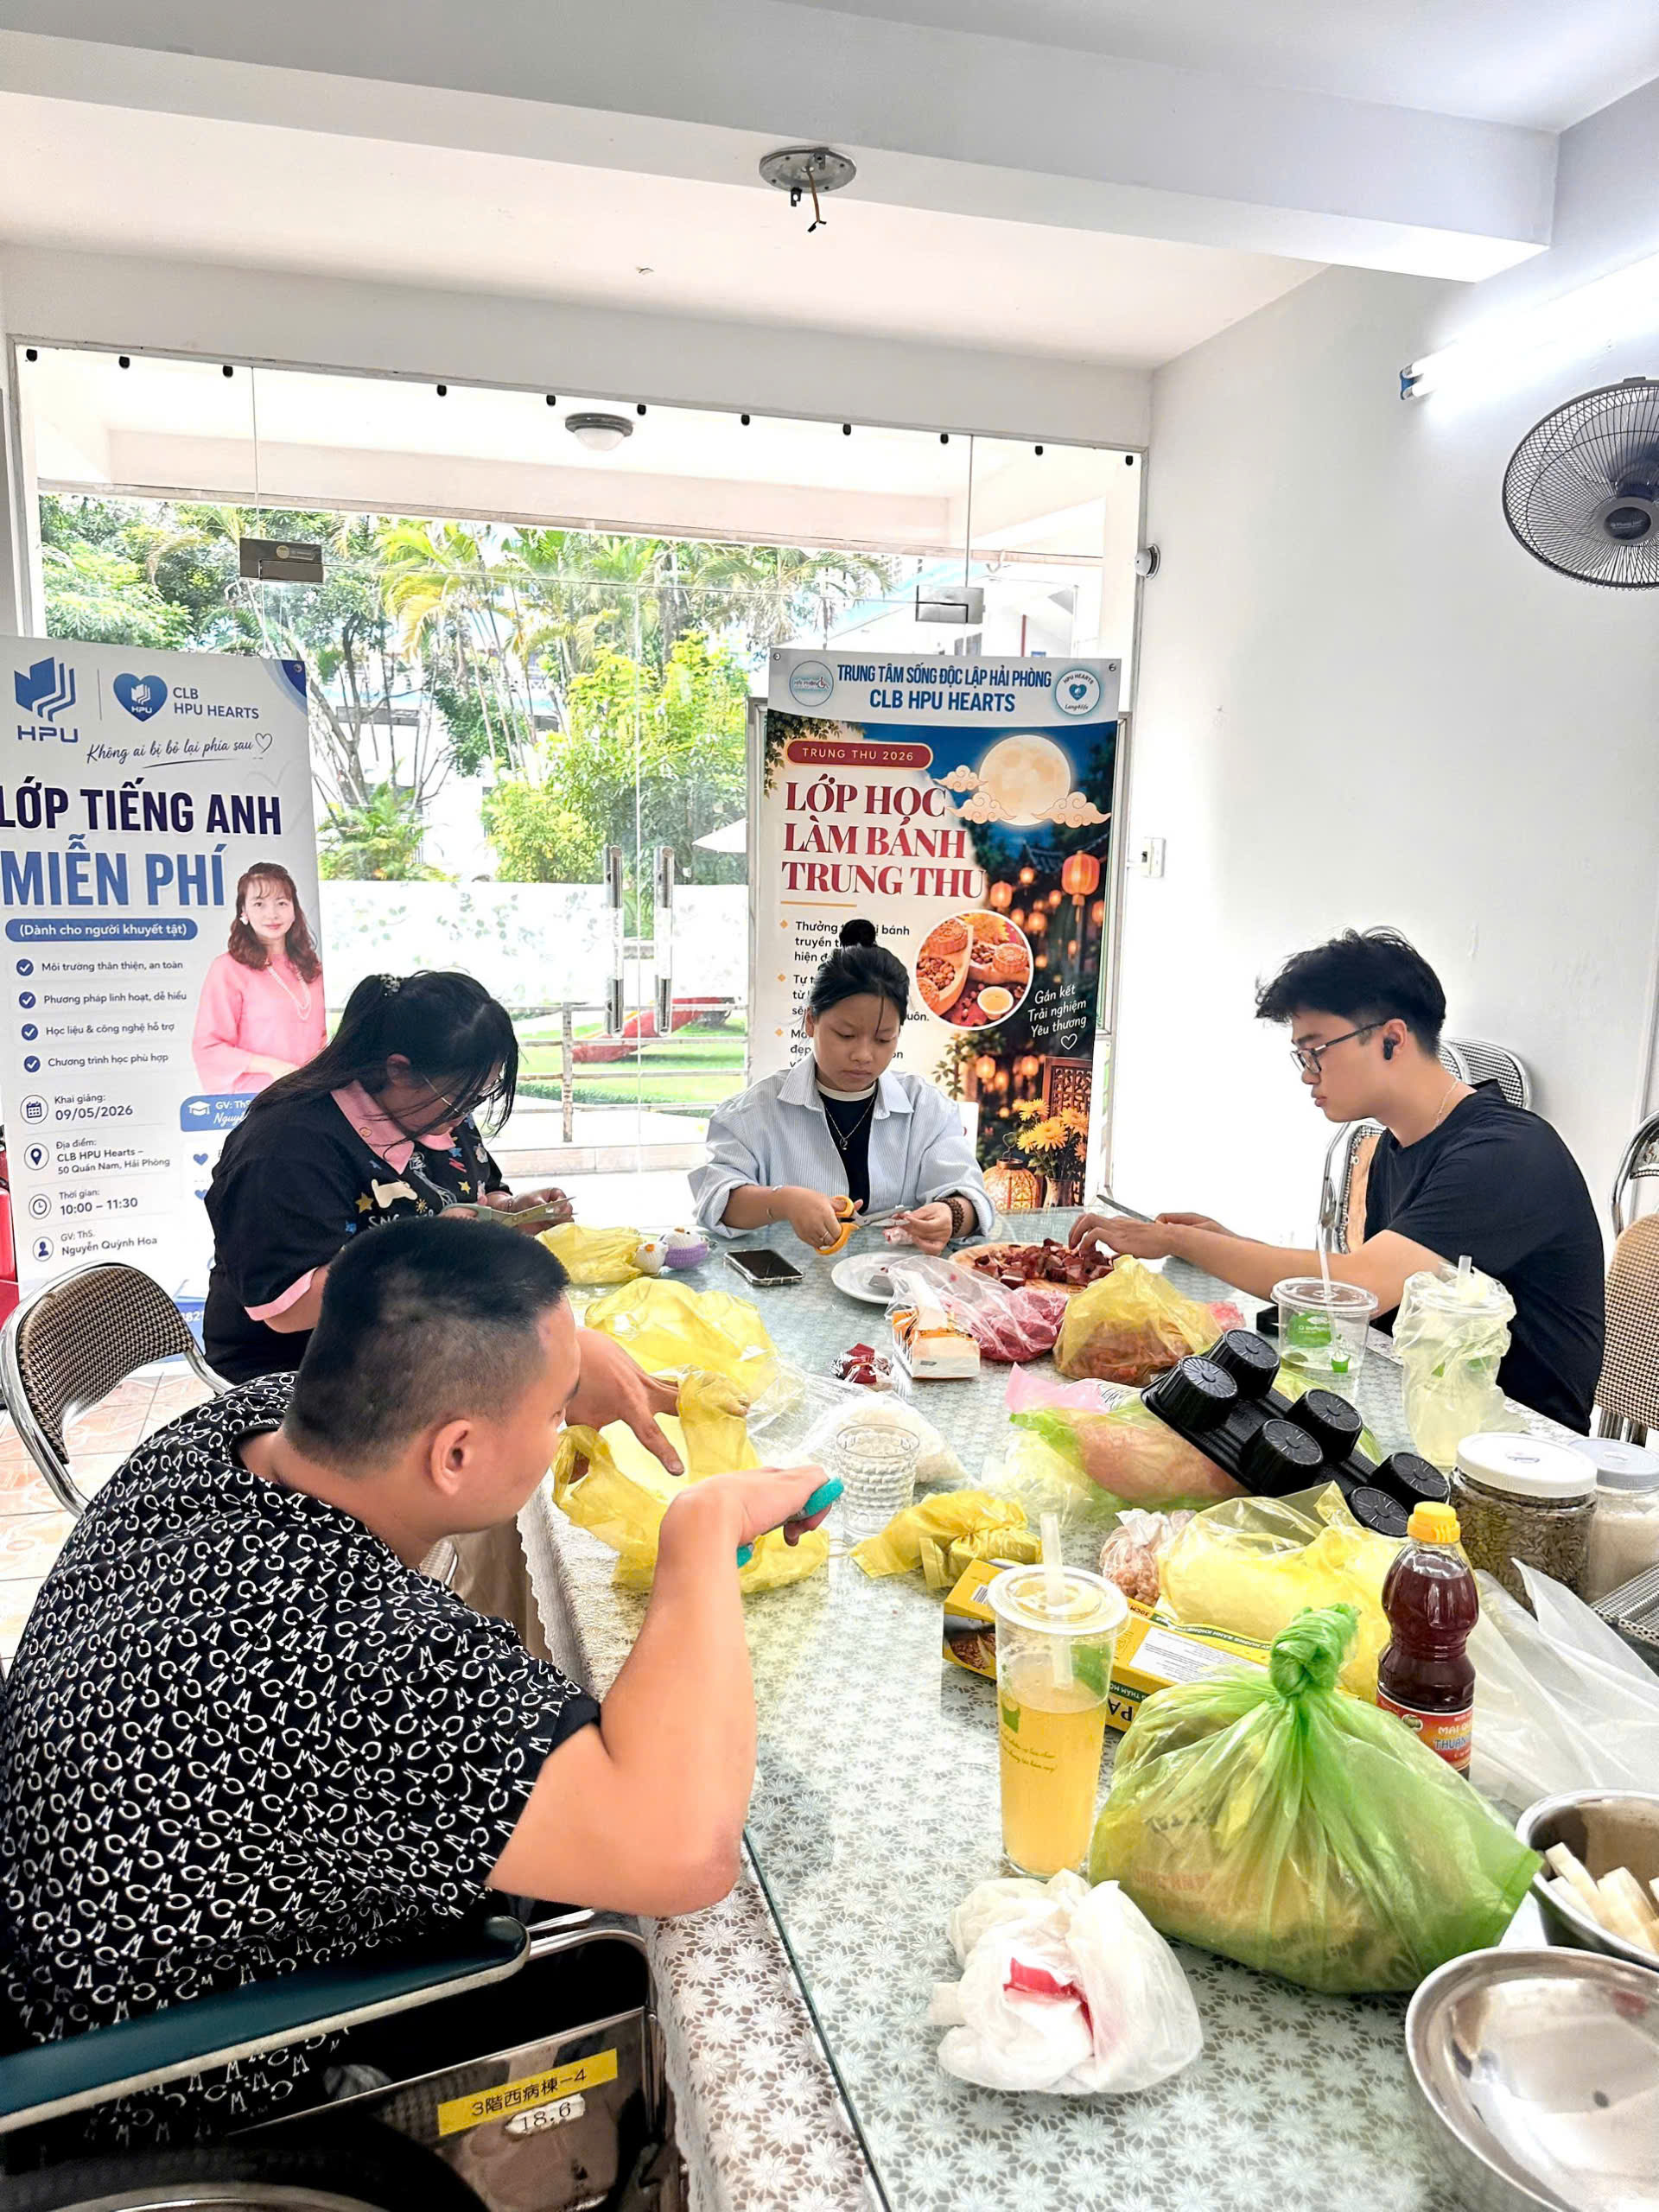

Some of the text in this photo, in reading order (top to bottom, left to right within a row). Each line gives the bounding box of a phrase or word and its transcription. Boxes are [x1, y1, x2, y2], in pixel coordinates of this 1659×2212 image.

[837, 662, 1052, 689] TRUNG TÂM SỐNG ĐỘC LẬP HẢI PHÒNG
[173, 687, 199, 699] CLB
[869, 689, 1016, 712] CLB HPU HEARTS
[174, 702, 259, 719] HPU HEARTS
[17, 725, 79, 743] HPU
[86, 737, 253, 765] Không ai bị bỏ lại phía sau
[802, 747, 913, 761] TRUNG THU 2026
[785, 773, 858, 813] LỚP
[0, 776, 283, 836] LỚP TIẾNG ANH
[784, 815, 968, 859] LÀM BÁNH
[0, 834, 227, 906] MIỄN PHÍ
[781, 861, 986, 899] TRUNG THU
[20, 923, 187, 938] (Dành cho người khuyết tật)
[796, 921, 838, 934] Thưởng
[881, 925, 910, 935] bánh
[795, 936, 831, 949] truyền
[794, 951, 817, 963] hiện
[42, 963, 60, 971] Môi
[62, 962, 95, 973] trường
[98, 961, 118, 970] thân
[121, 961, 147, 972] thiện,
[163, 961, 183, 969] toàn
[793, 975, 808, 988] Tự
[44, 995, 80, 1005] Phương
[83, 994, 106, 1005] pháp
[128, 993, 151, 1002] hoạt,
[154, 991, 165, 1001] dễ
[168, 990, 187, 1001] hiểu
[1059, 983, 1076, 998] kết
[1027, 1000, 1086, 1022] Trải nghiệm
[46, 1027, 65, 1036] Học
[67, 1026, 83, 1035] liệu
[86, 1025, 93, 1033] &
[96, 1025, 119, 1034] công
[122, 1023, 145, 1033] nghệ
[162, 1023, 175, 1032] trợ
[1031, 1016, 1086, 1038] Yêu thương
[790, 1045, 811, 1057] đẹp
[48, 1052, 168, 1067] Chương trình học phù hợp
[54, 1093, 106, 1105] Khai giảng:
[215, 1101, 232, 1109] GV:
[55, 1104, 133, 1122] 09/05/2026
[55, 1137, 97, 1150] Địa điểm:
[57, 1153, 77, 1162] CLB
[79, 1150, 101, 1160] HPU
[104, 1148, 136, 1158] Hearts
[58, 1166, 69, 1175] 50
[98, 1162, 122, 1171] Nam,
[142, 1158, 170, 1167] Phòng
[79, 1189, 100, 1199] gian:
[60, 1202, 92, 1216] 10:00
[106, 1198, 138, 1210] 11:30
[60, 1232, 76, 1243] GV:
[61, 1241, 99, 1256] Nguyễn
[137, 1236, 157, 1246] Hoa
[522, 2101, 571, 2131] 18.6
